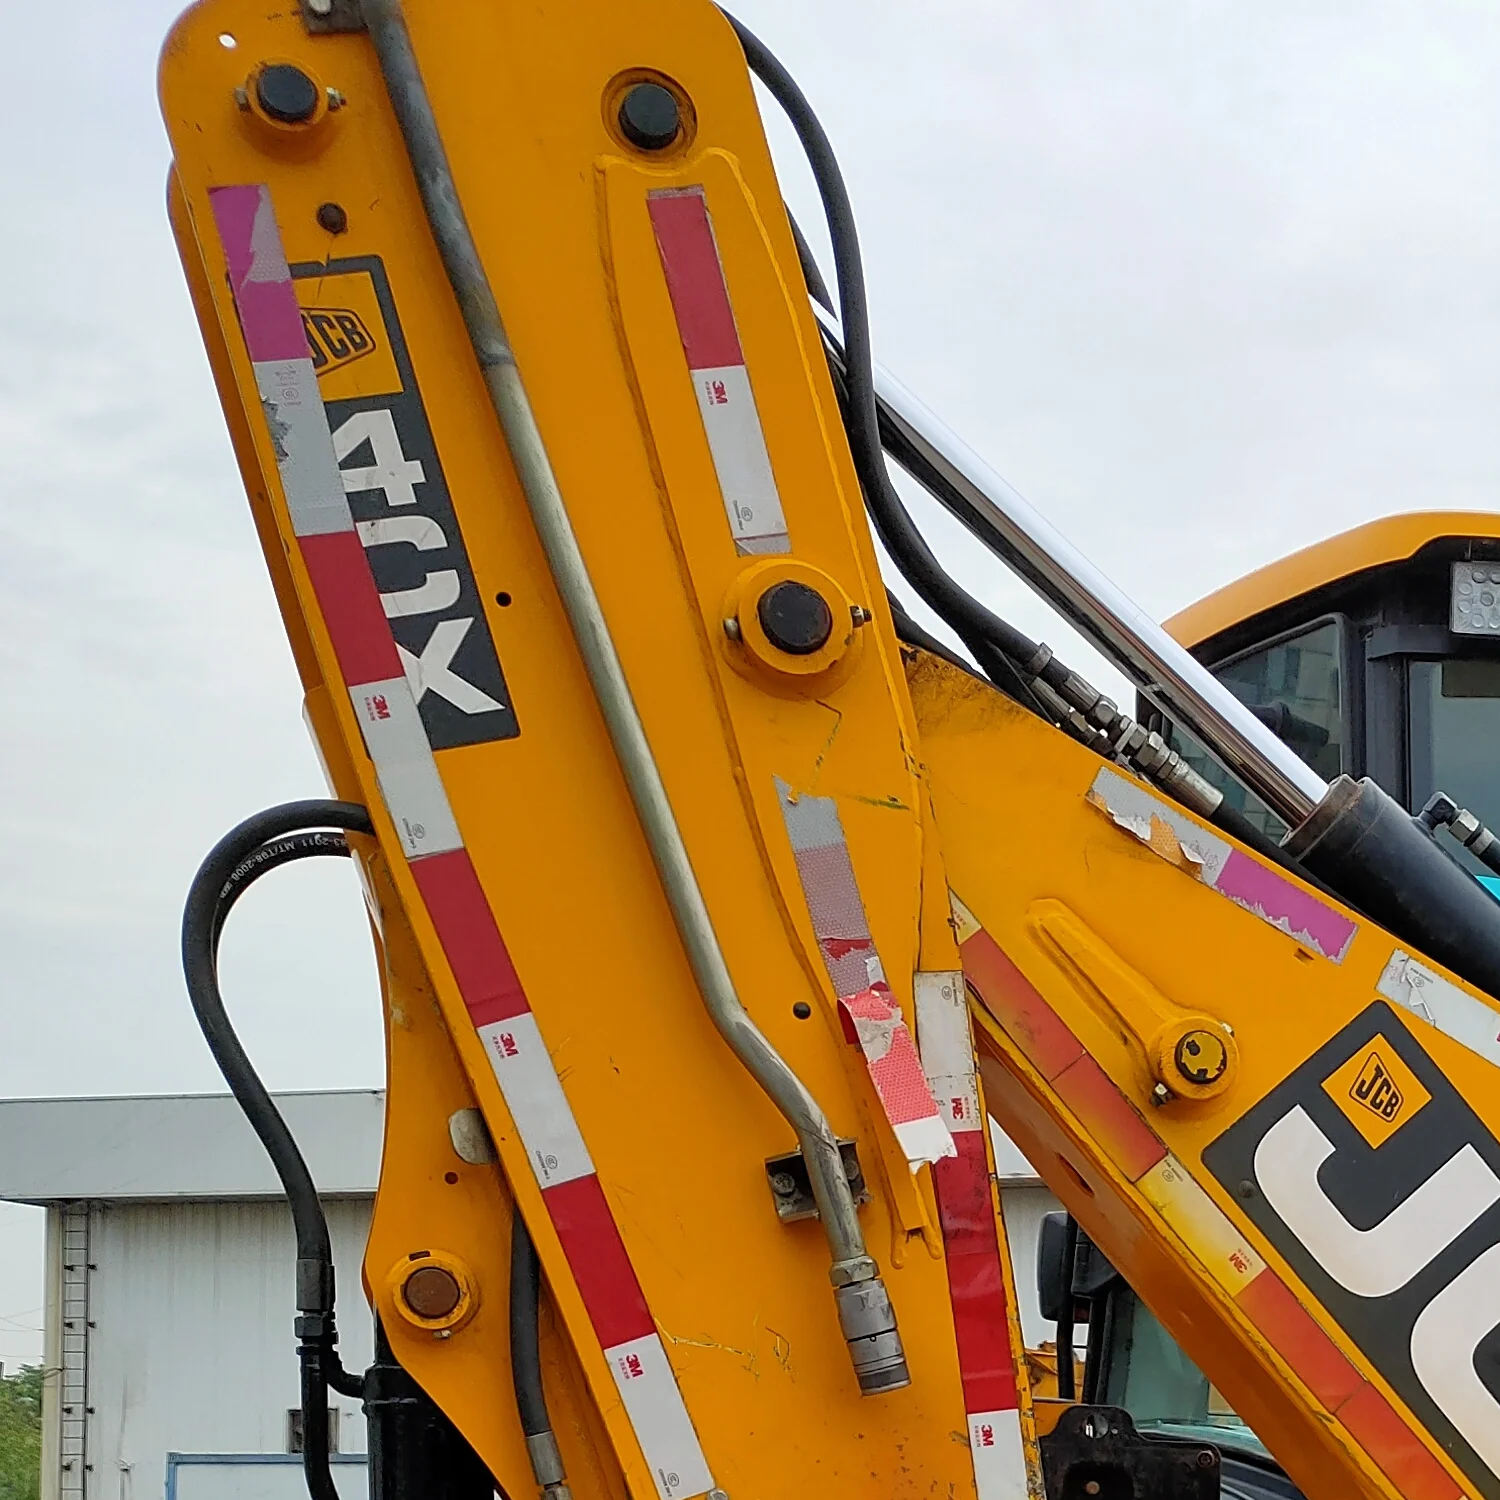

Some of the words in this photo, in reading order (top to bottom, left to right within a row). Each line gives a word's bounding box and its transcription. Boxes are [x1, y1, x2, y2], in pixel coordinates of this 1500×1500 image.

[712, 381, 728, 404] 3M
[372, 695, 391, 719] 3M
[500, 1033, 519, 1057] 3M
[1356, 1064, 1399, 1117] JCB
[951, 1097, 963, 1119] 3M
[1228, 1253, 1247, 1273] 3M
[625, 1354, 644, 1377] 3M
[981, 1424, 994, 1446] 3M
